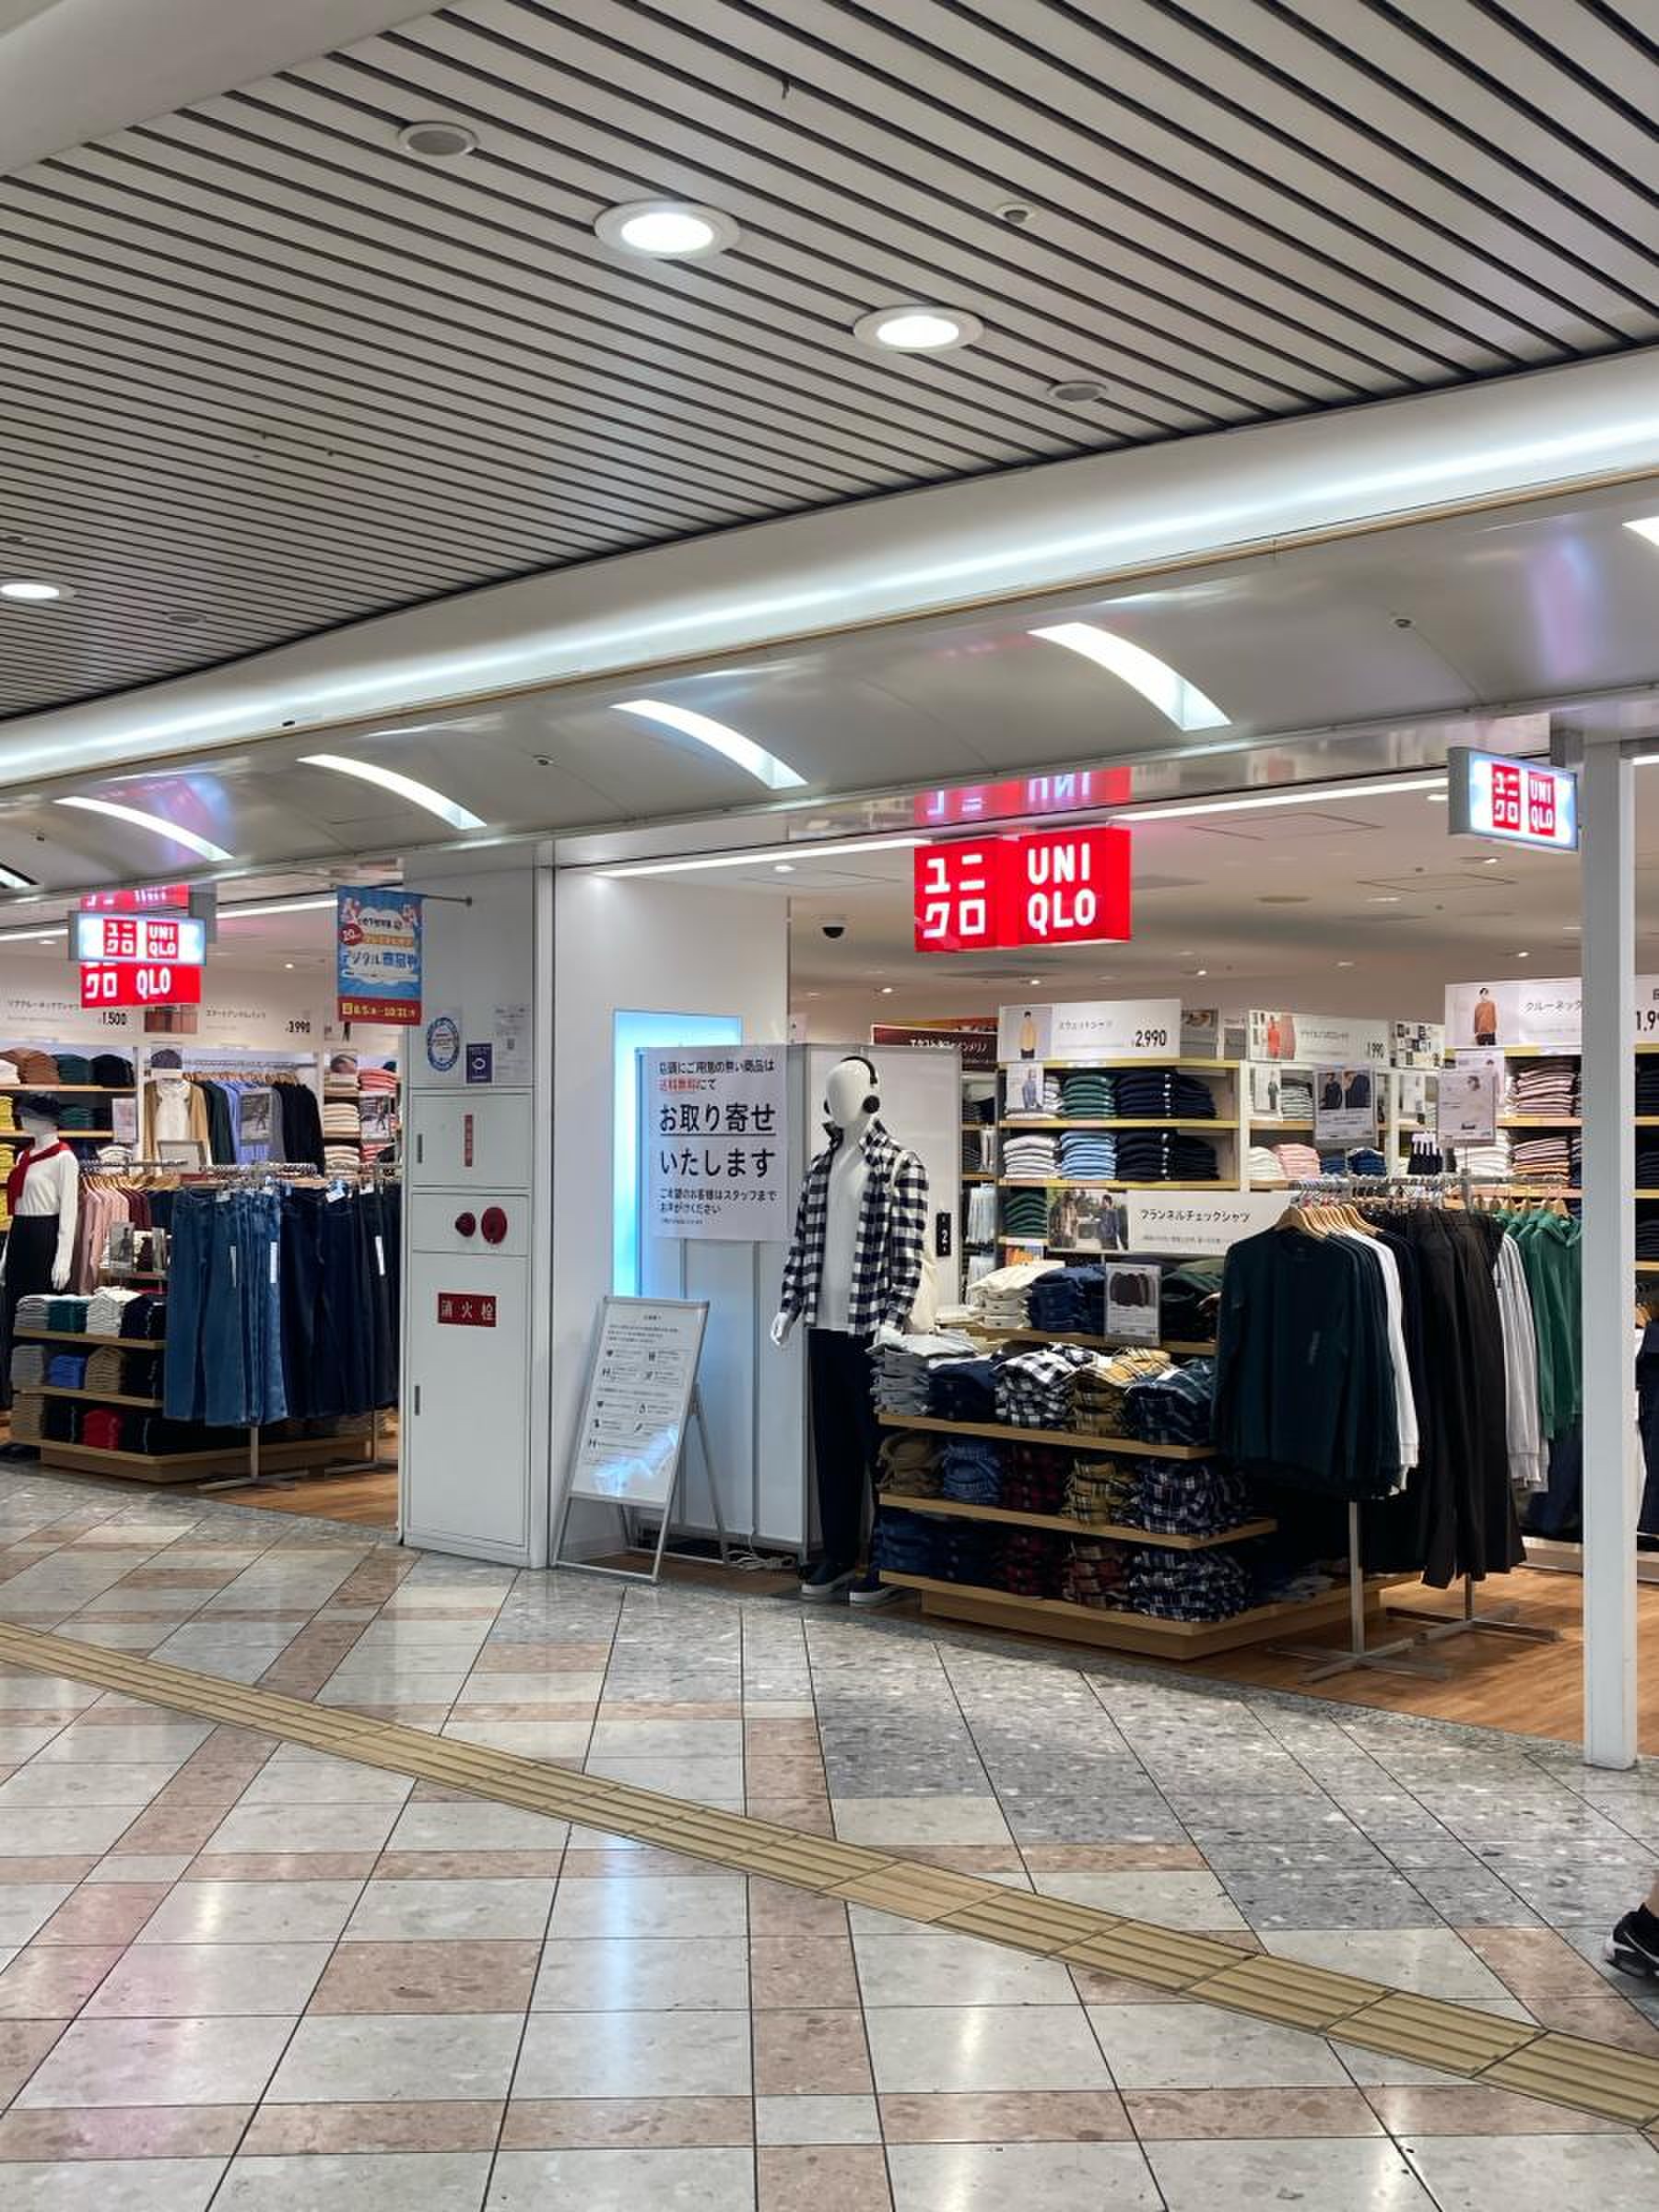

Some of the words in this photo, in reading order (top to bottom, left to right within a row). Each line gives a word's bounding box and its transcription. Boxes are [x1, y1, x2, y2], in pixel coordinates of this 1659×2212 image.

[1494, 771, 1519, 797] ユニ
[1529, 779, 1553, 804] UNI
[1494, 799, 1519, 824] クロ
[1530, 806, 1554, 832] QLO
[924, 853, 987, 894] ユニ
[1027, 842, 1091, 886] UNI
[923, 899, 986, 939] クロ
[1027, 888, 1097, 936] QLO
[107, 923, 134, 938] ユニ
[148, 924, 175, 939] UNI
[106, 939, 134, 954] クロ
[148, 942, 177, 957] QLO
[85, 972, 118, 999] クロ
[135, 968, 171, 1000] QLO
[659, 1102, 776, 1133] お取り寄せ
[660, 1147, 776, 1178] いたします
[441, 1300, 494, 1322] 消火栓
